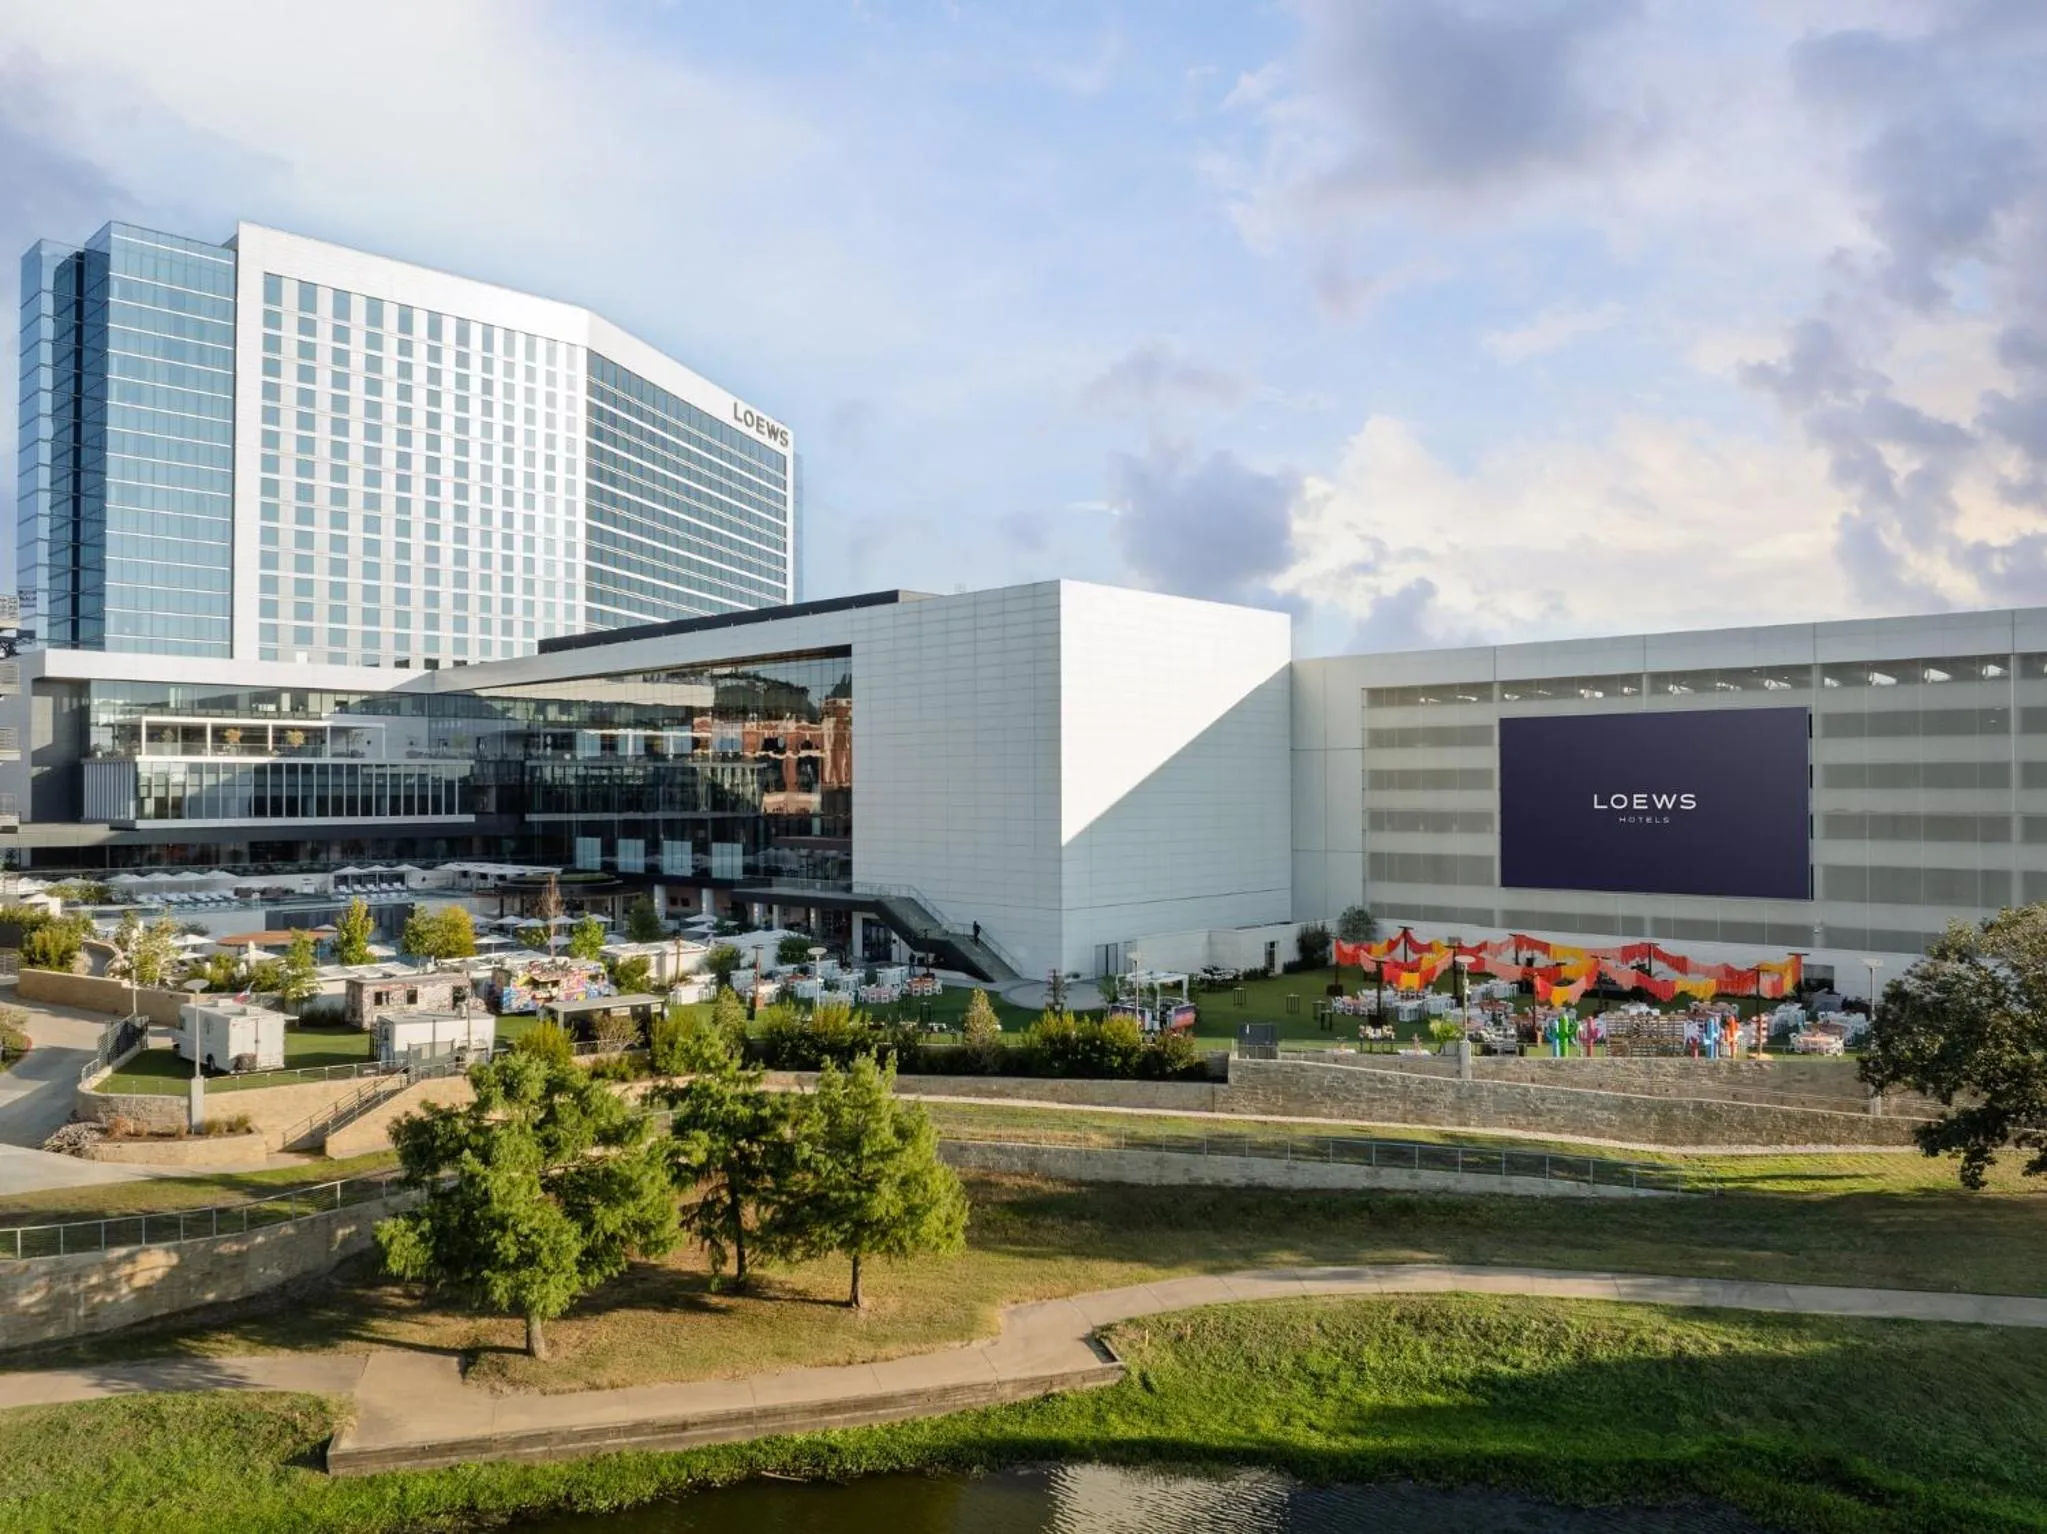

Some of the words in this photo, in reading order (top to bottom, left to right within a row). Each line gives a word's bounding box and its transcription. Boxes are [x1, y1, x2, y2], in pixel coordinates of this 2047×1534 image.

[733, 401, 789, 448] LOEWS
[1593, 793, 1697, 810] LOEWS
[1619, 816, 1670, 824] HOTELS
